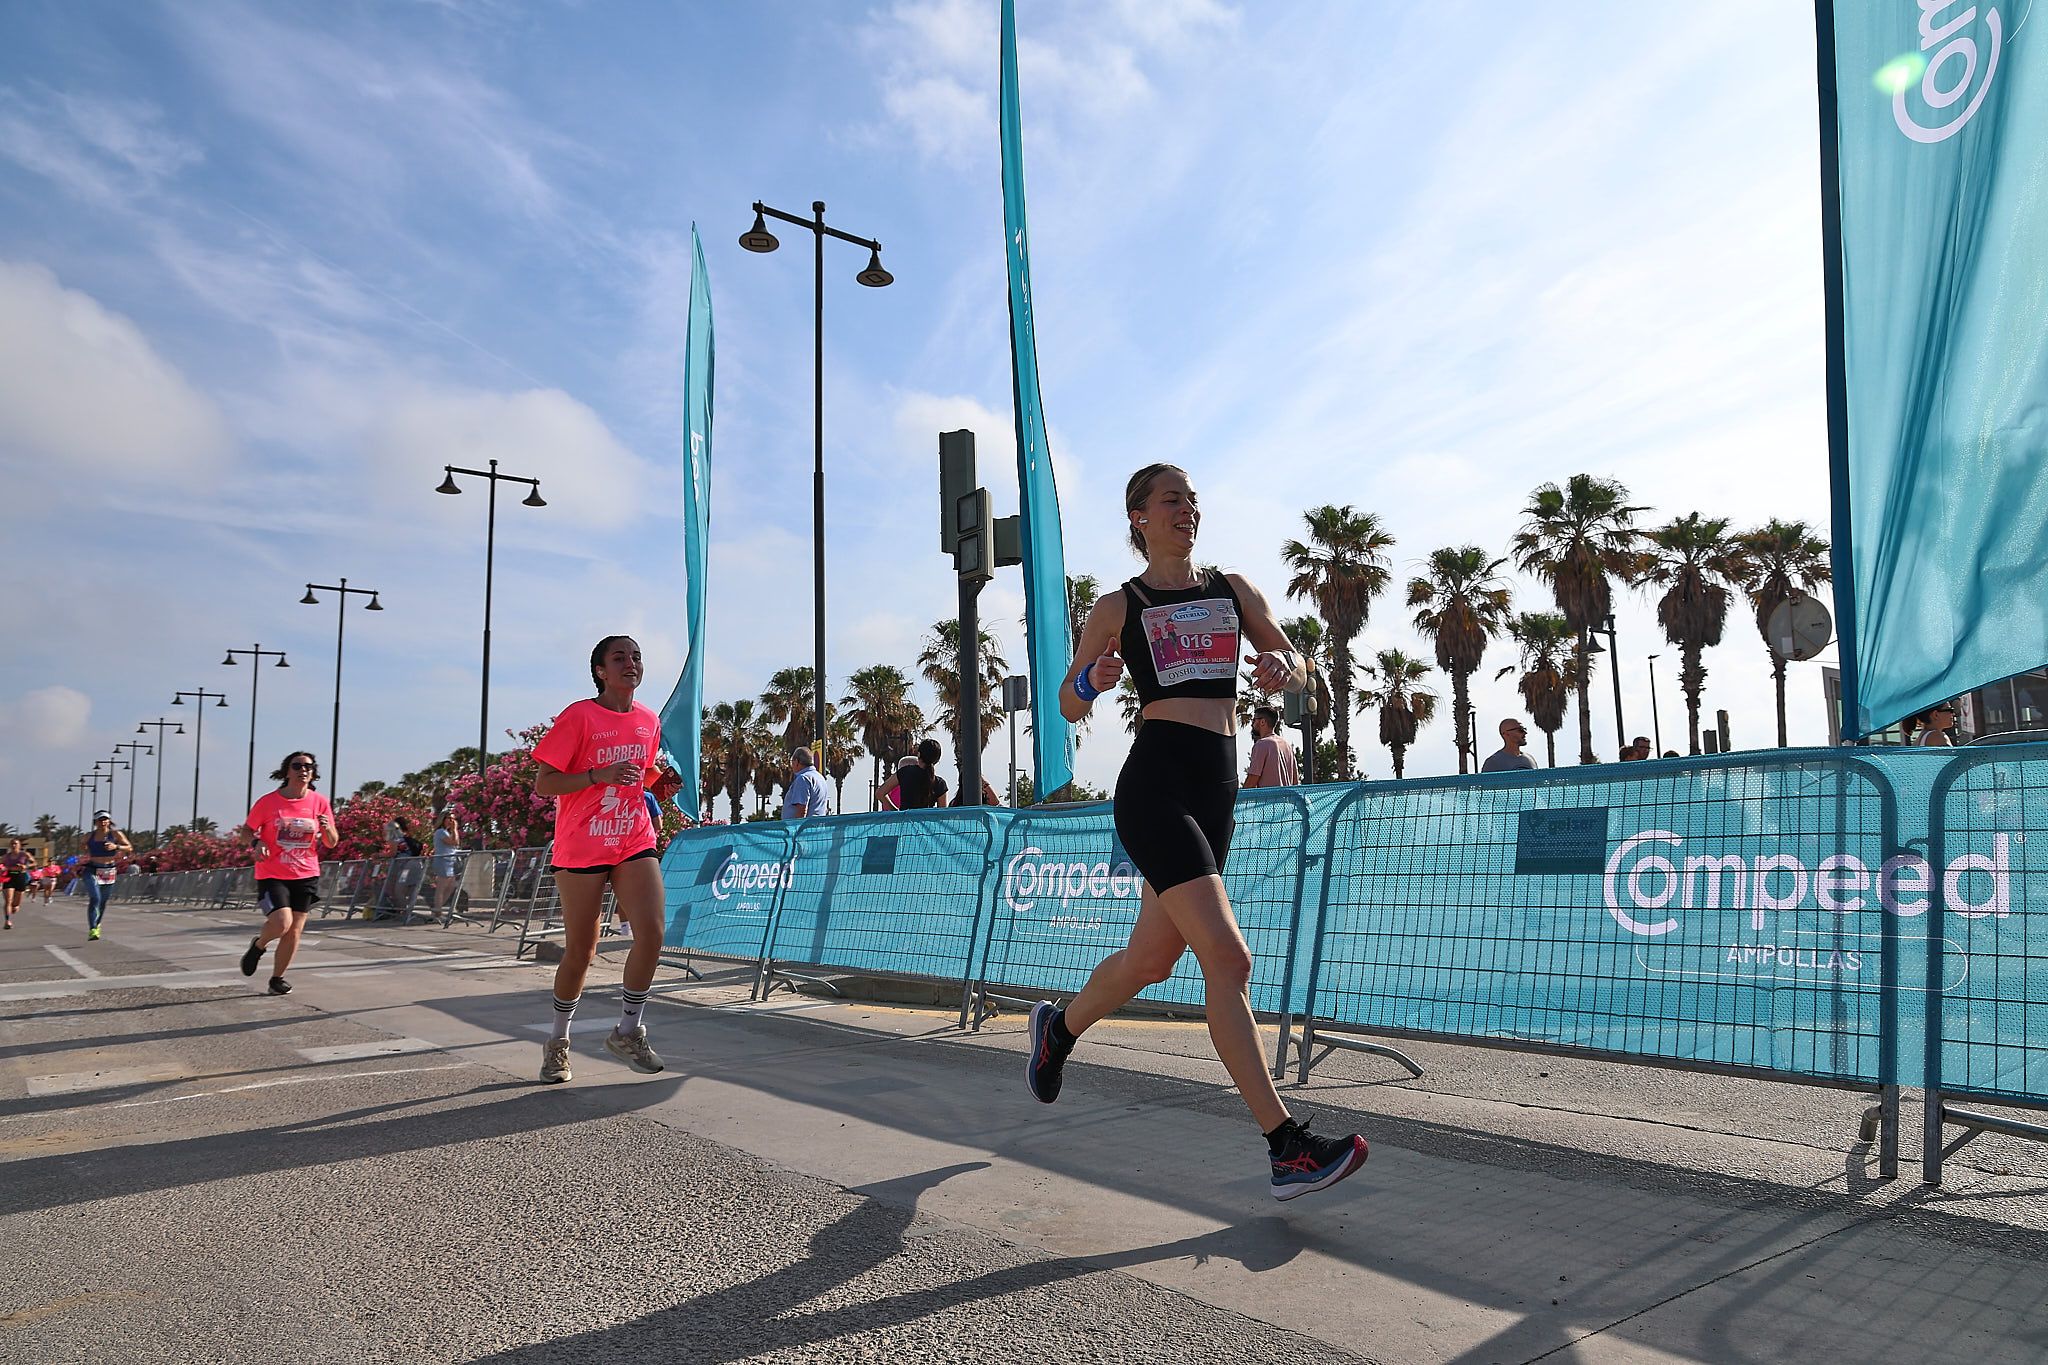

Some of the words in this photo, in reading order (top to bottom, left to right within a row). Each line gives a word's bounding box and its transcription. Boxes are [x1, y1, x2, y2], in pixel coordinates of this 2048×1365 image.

[1180, 634, 1213, 649] 016
[1168, 667, 1196, 680] OYSHO
[592, 730, 618, 741] OYSHO
[597, 744, 648, 765] CARRERA
[711, 852, 798, 901] Compeed
[1603, 829, 2010, 937] Compeed
[1049, 915, 1102, 931] AMPOLLAS
[1726, 943, 1863, 971] AMPOLLAS
